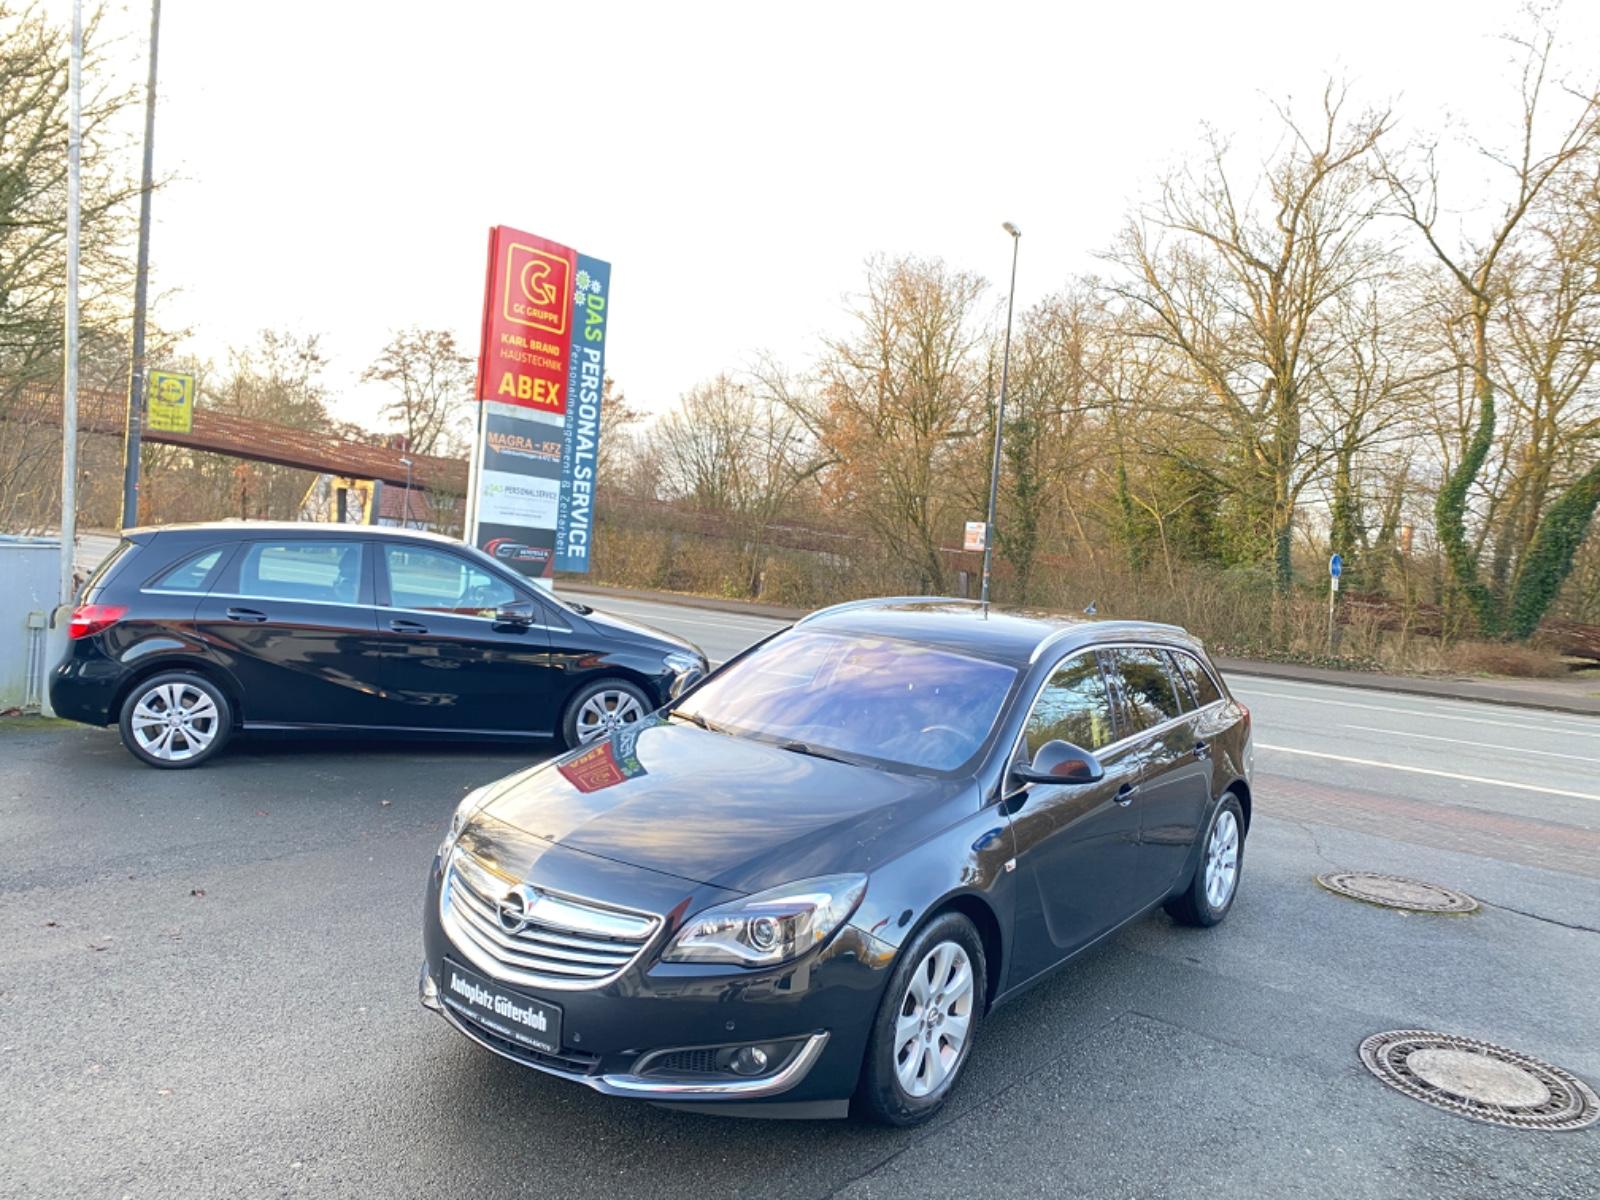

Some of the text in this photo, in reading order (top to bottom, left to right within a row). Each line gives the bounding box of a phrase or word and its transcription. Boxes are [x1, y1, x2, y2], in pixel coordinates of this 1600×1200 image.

[513, 303, 559, 324] GC GRUPPE
[500, 333, 560, 356] KARL BRAND
[500, 349, 562, 371] HAUSTECHNIK
[498, 372, 560, 406] ABEX
[561, 344, 581, 474] Personalmanagement
[568, 293, 605, 558] DAS PERSONALSERVICE
[488, 431, 533, 450] MAGRA
[542, 440, 561, 455] KFZ
[556, 495, 570, 555] Zeitarbeit
[450, 972, 494, 1011] Autoplatz
[494, 995, 547, 1032] Gütersloh
